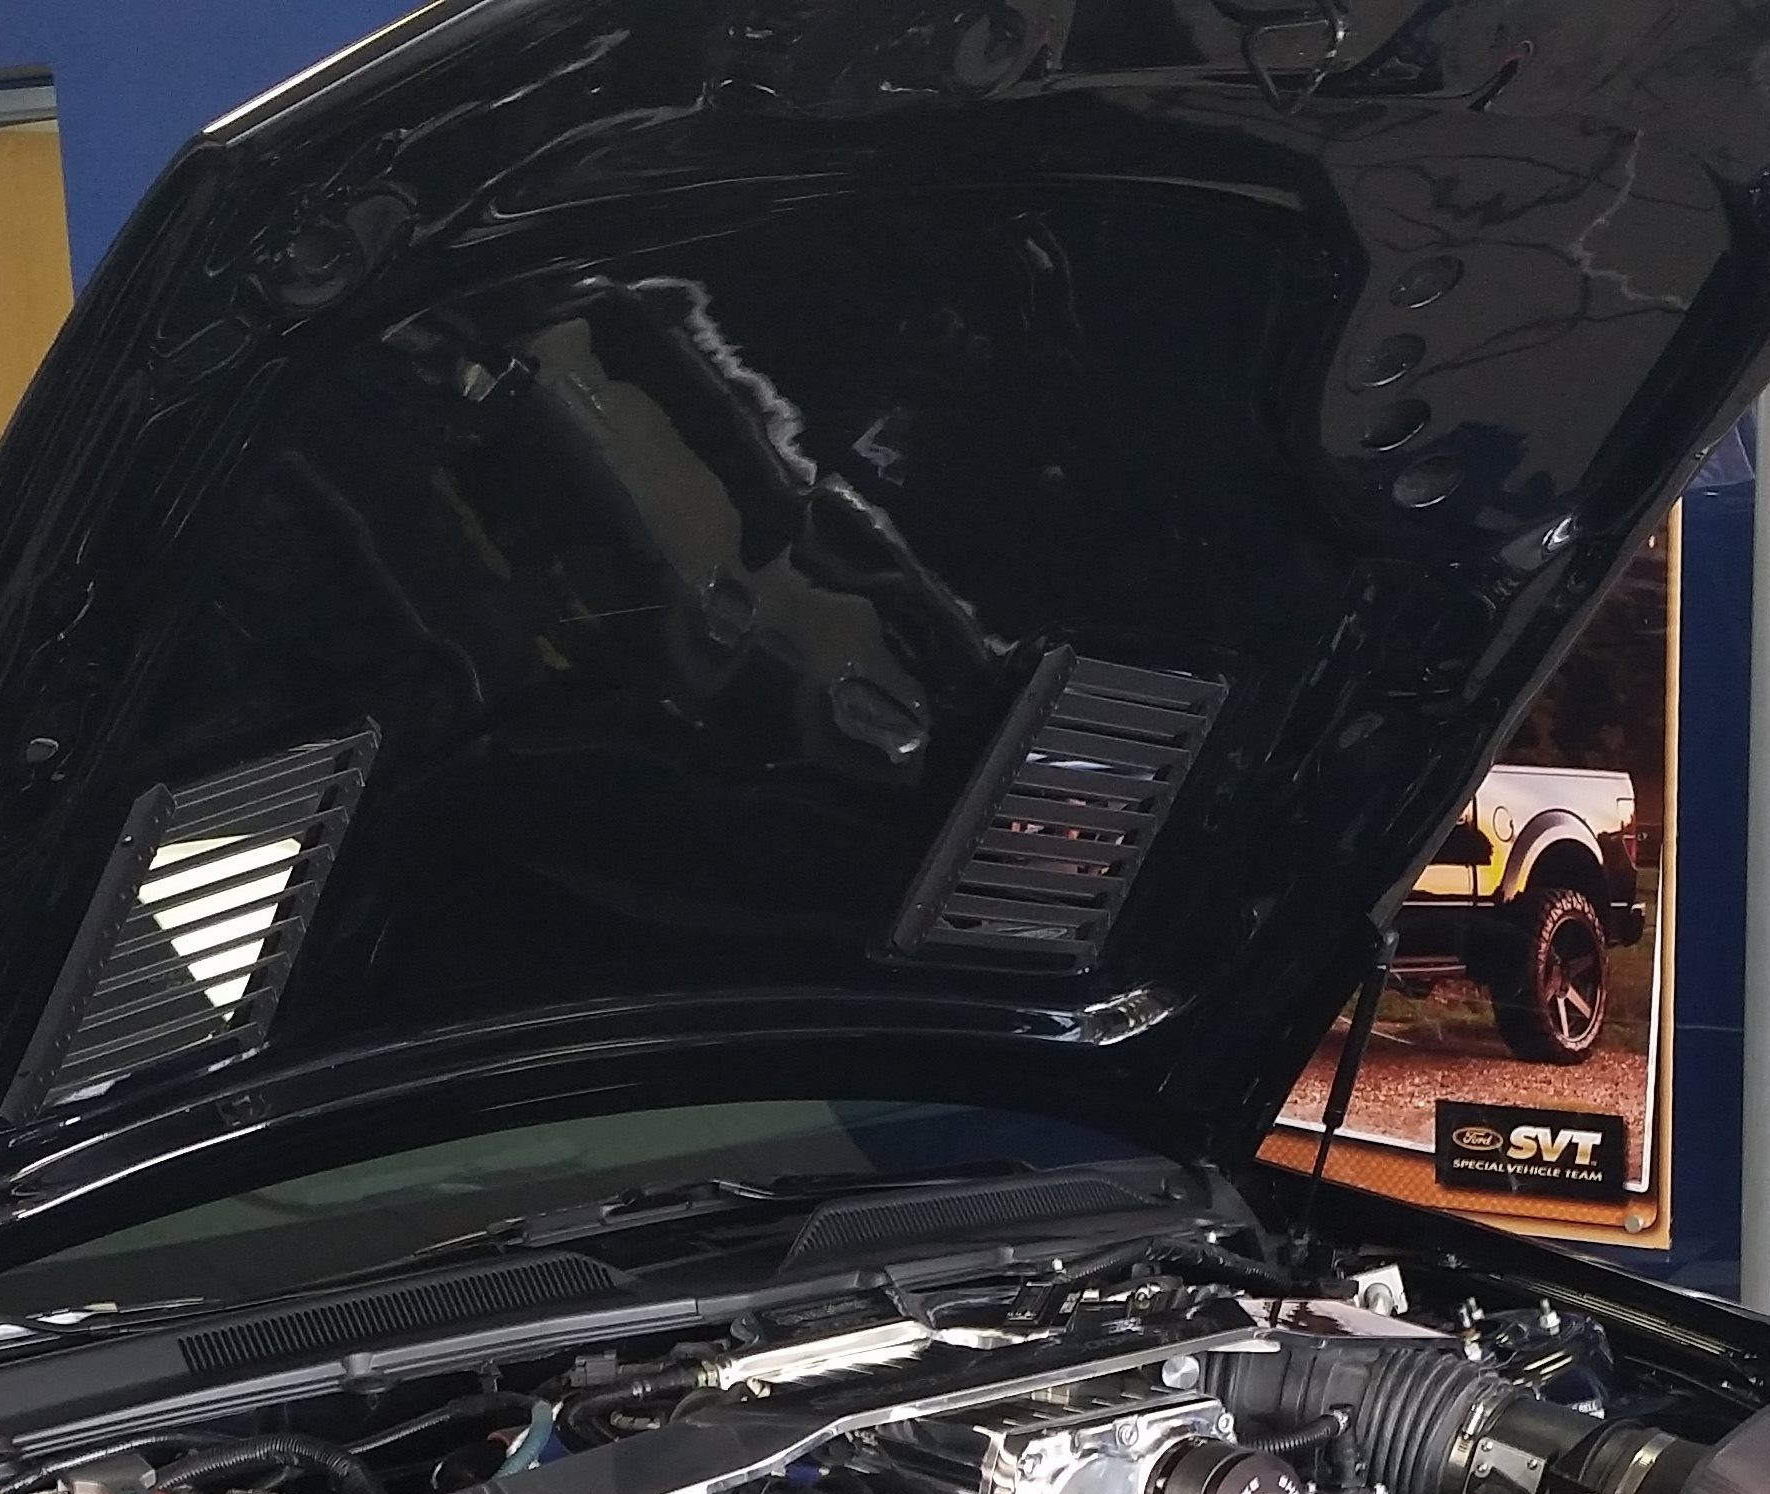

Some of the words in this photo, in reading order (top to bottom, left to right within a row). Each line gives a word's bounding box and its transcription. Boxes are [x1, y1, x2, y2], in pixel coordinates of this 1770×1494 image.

[1507, 1125, 1603, 1166] SVT
[1453, 1158, 1505, 1173] SPECIAL
[1506, 1162, 1561, 1178] VEHICLE
[1565, 1169, 1603, 1182] TEAM
